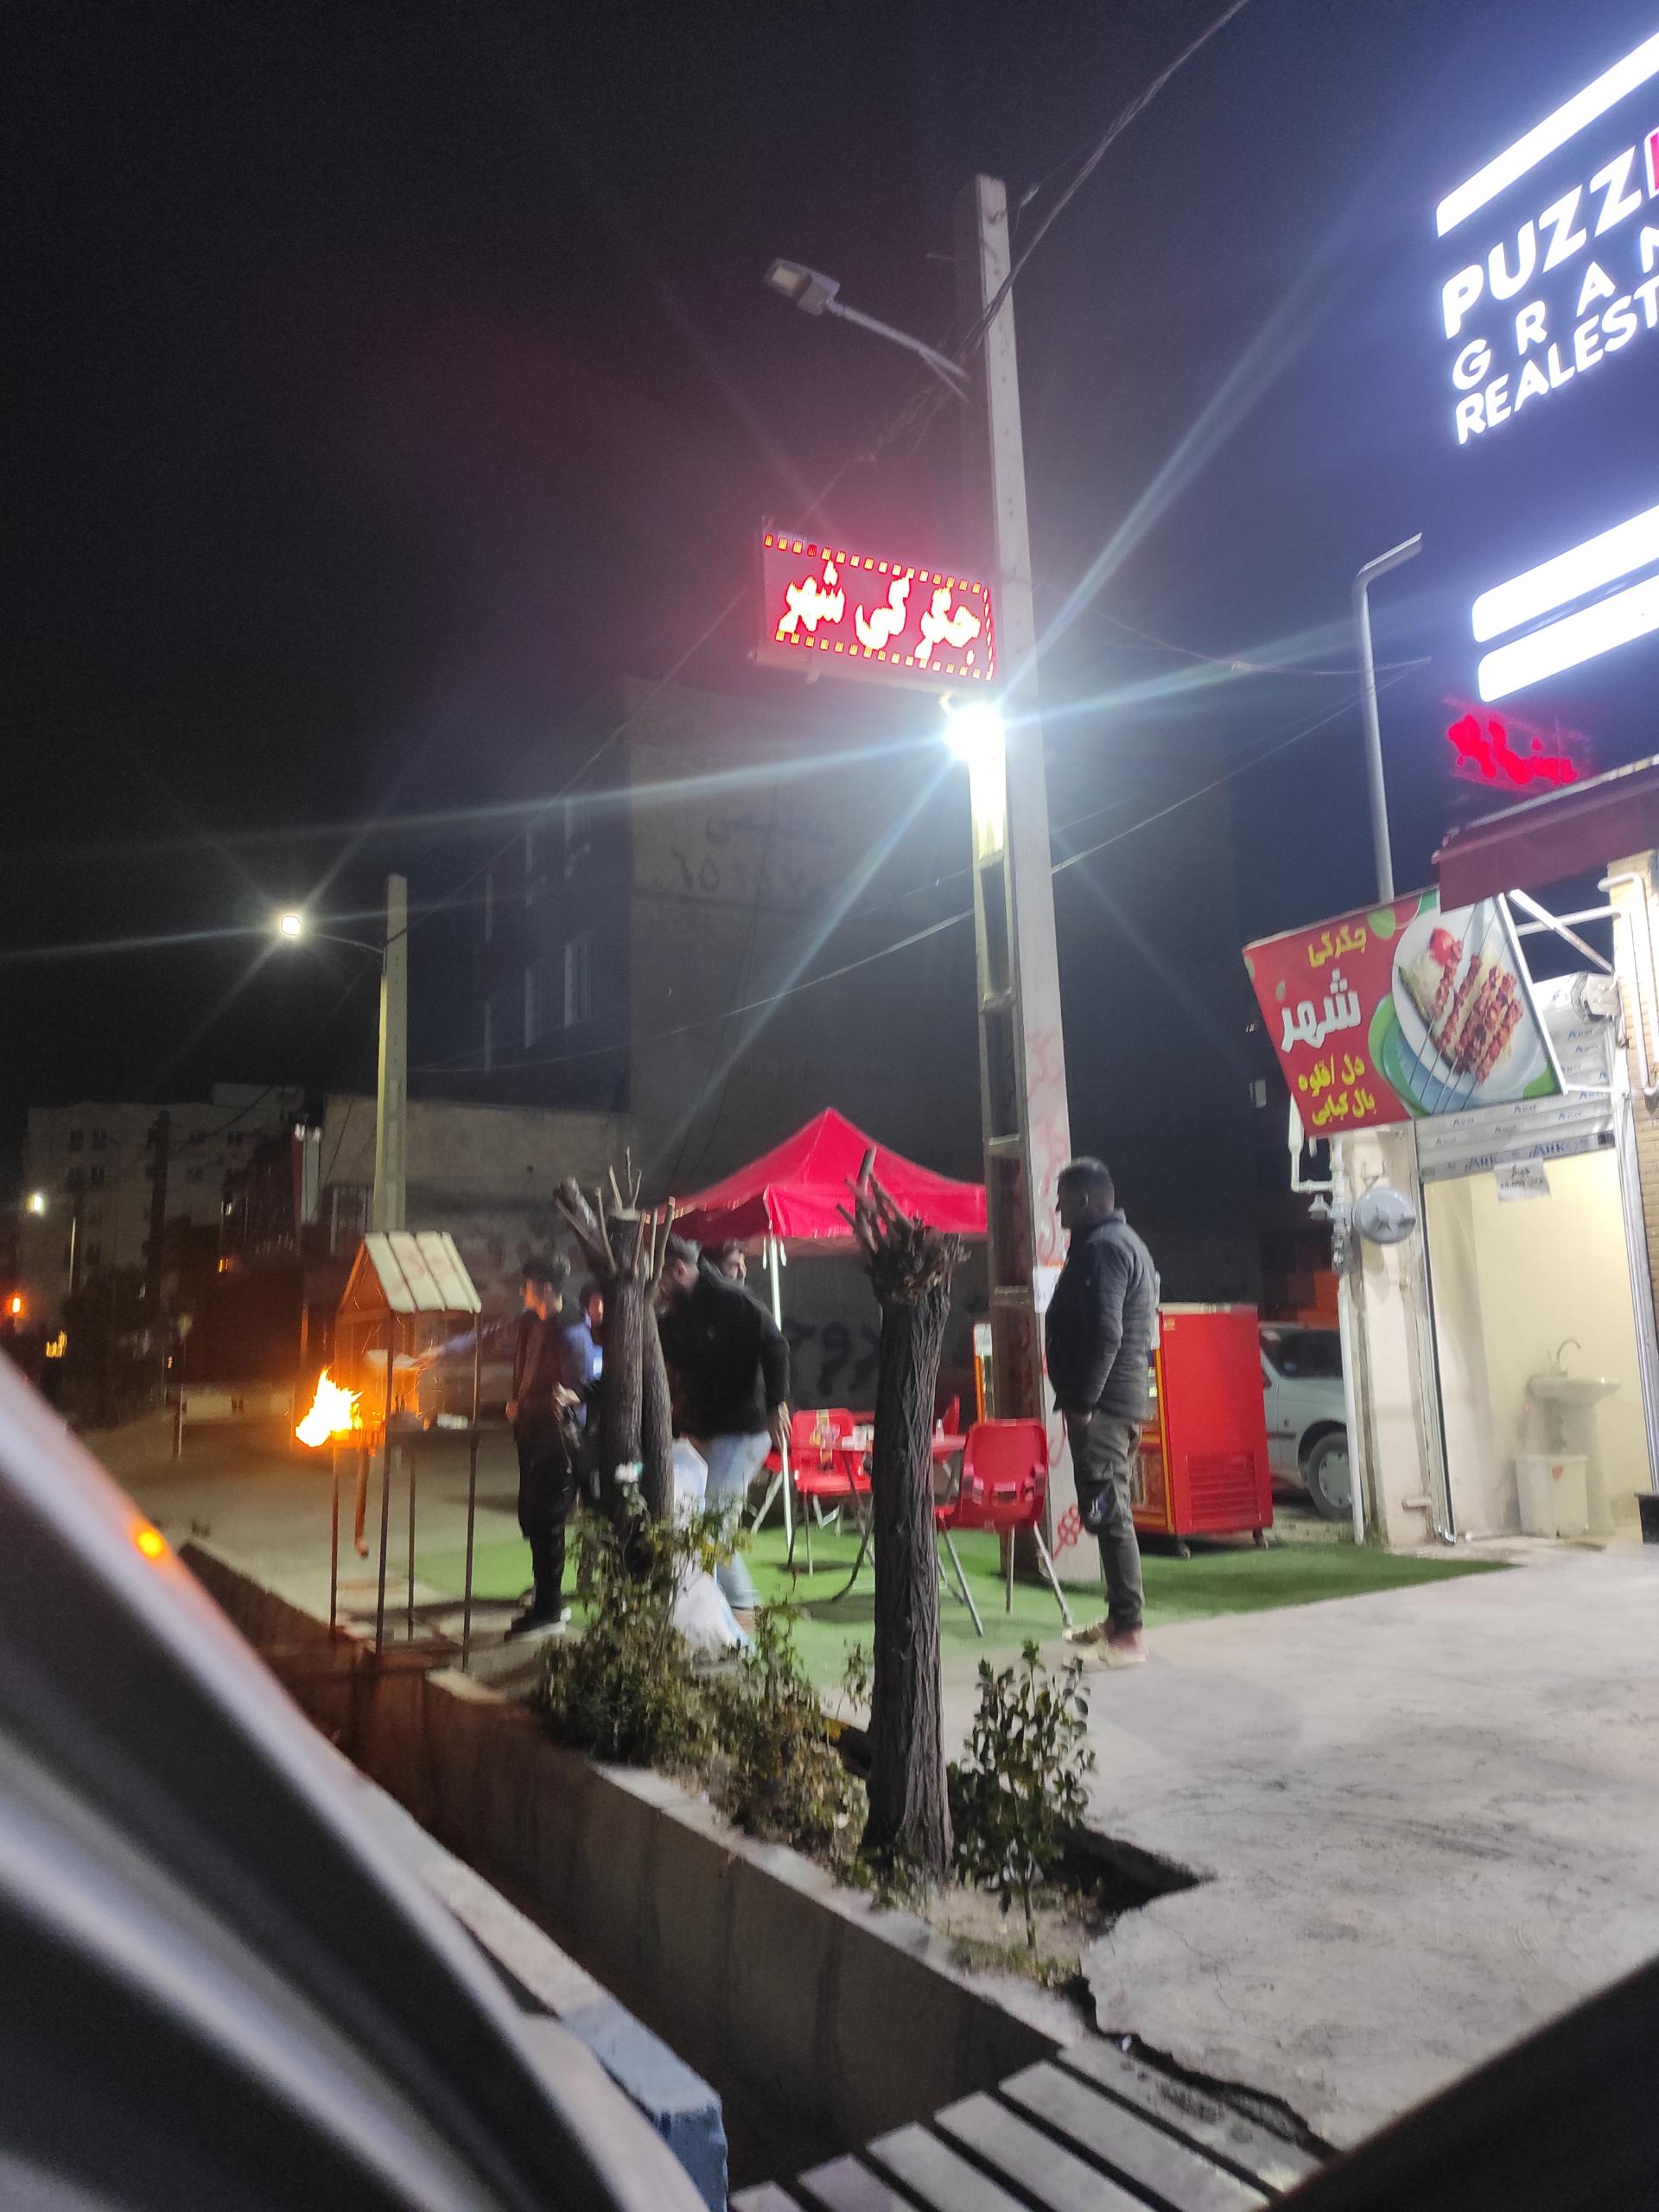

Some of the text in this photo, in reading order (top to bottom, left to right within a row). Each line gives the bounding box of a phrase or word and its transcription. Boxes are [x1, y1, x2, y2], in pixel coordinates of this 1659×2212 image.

[778, 560, 845, 633] شهر
[1280, 968, 1362, 1053] شهر
[1341, 1052, 1366, 1086] دل
[1351, 1087, 1377, 1118] بال
